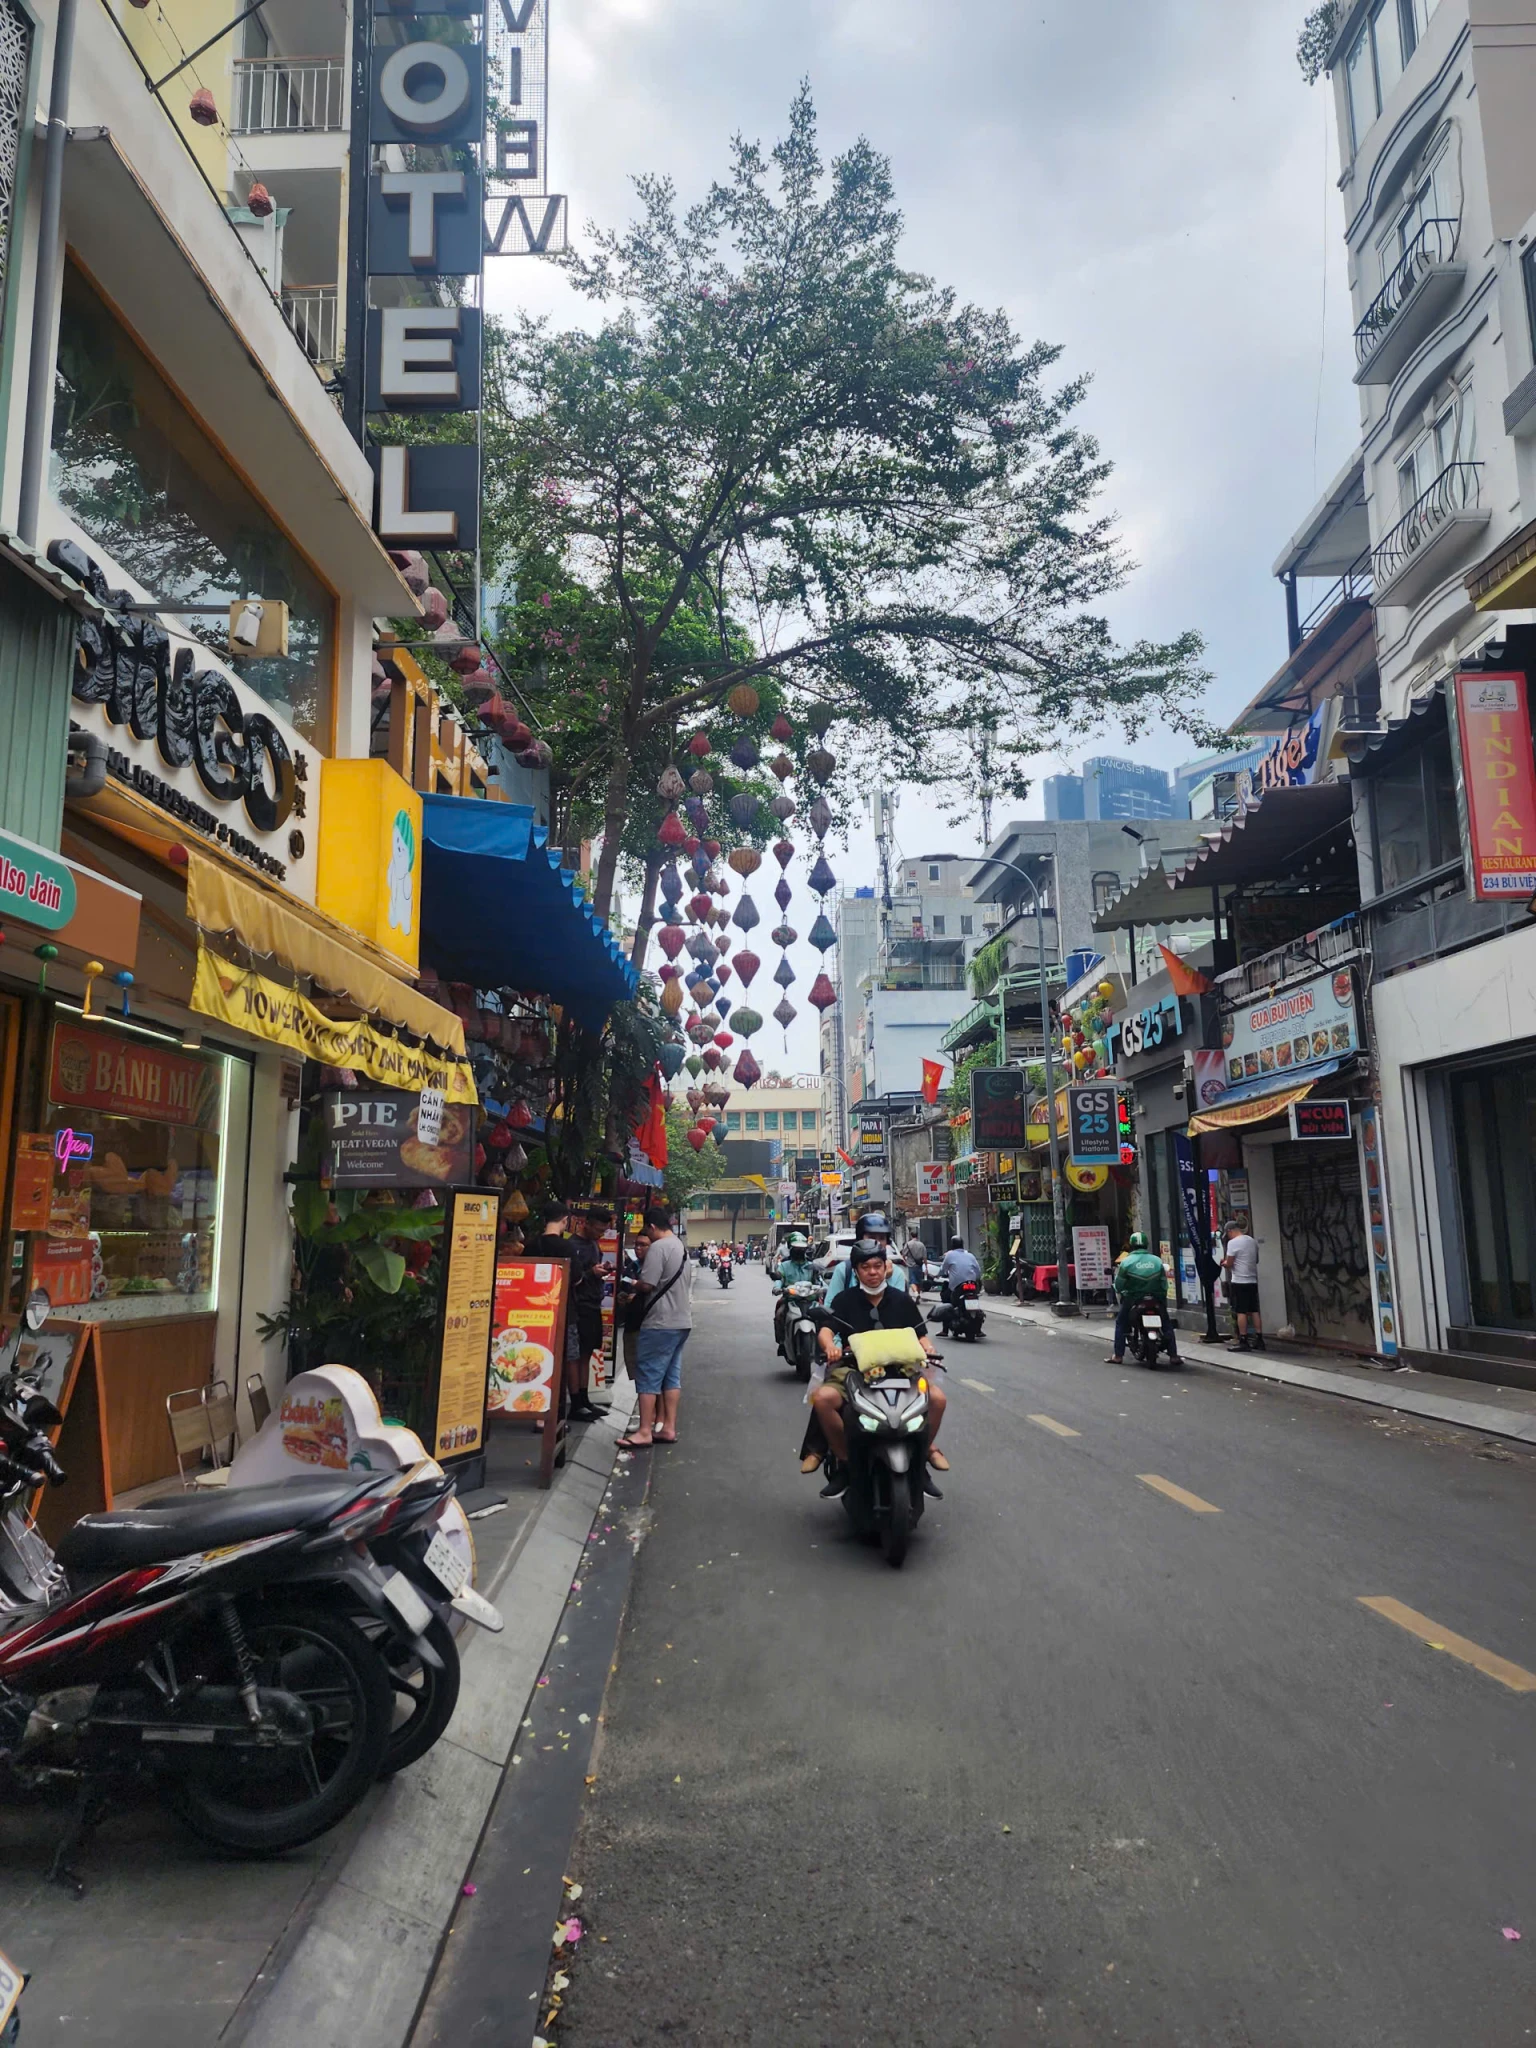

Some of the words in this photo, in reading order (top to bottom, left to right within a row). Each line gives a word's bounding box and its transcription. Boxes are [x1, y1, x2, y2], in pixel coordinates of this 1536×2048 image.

[378, 41, 469, 540] OTEL
[1100, 759, 1145, 775] LANCASTER
[1256, 722, 1310, 795] Tiger
[1484, 714, 1524, 856] INDIAN
[0, 852, 26, 897] lso
[29, 872, 61, 911] Jain
[1483, 877, 1499, 889] 234
[1250, 1005, 1270, 1030] CUA
[1122, 1001, 1164, 1058] GS25
[95, 1045, 162, 1103] BÁNH
[1076, 1092, 1110, 1113] GS
[1312, 1106, 1345, 1120] CUA
[331, 1102, 398, 1129] PIE
[861, 1120, 878, 1131] PAPA
[1079, 1113, 1110, 1134] 25
[57, 1127, 92, 1174] Open
[332, 1139, 362, 1149] MEAT
[364, 1139, 398, 1148] VEGAN
[1081, 1139, 1110, 1147] Lifestyle
[346, 1160, 384, 1169] Welcome
[1135, 1261, 1155, 1269] Grab
